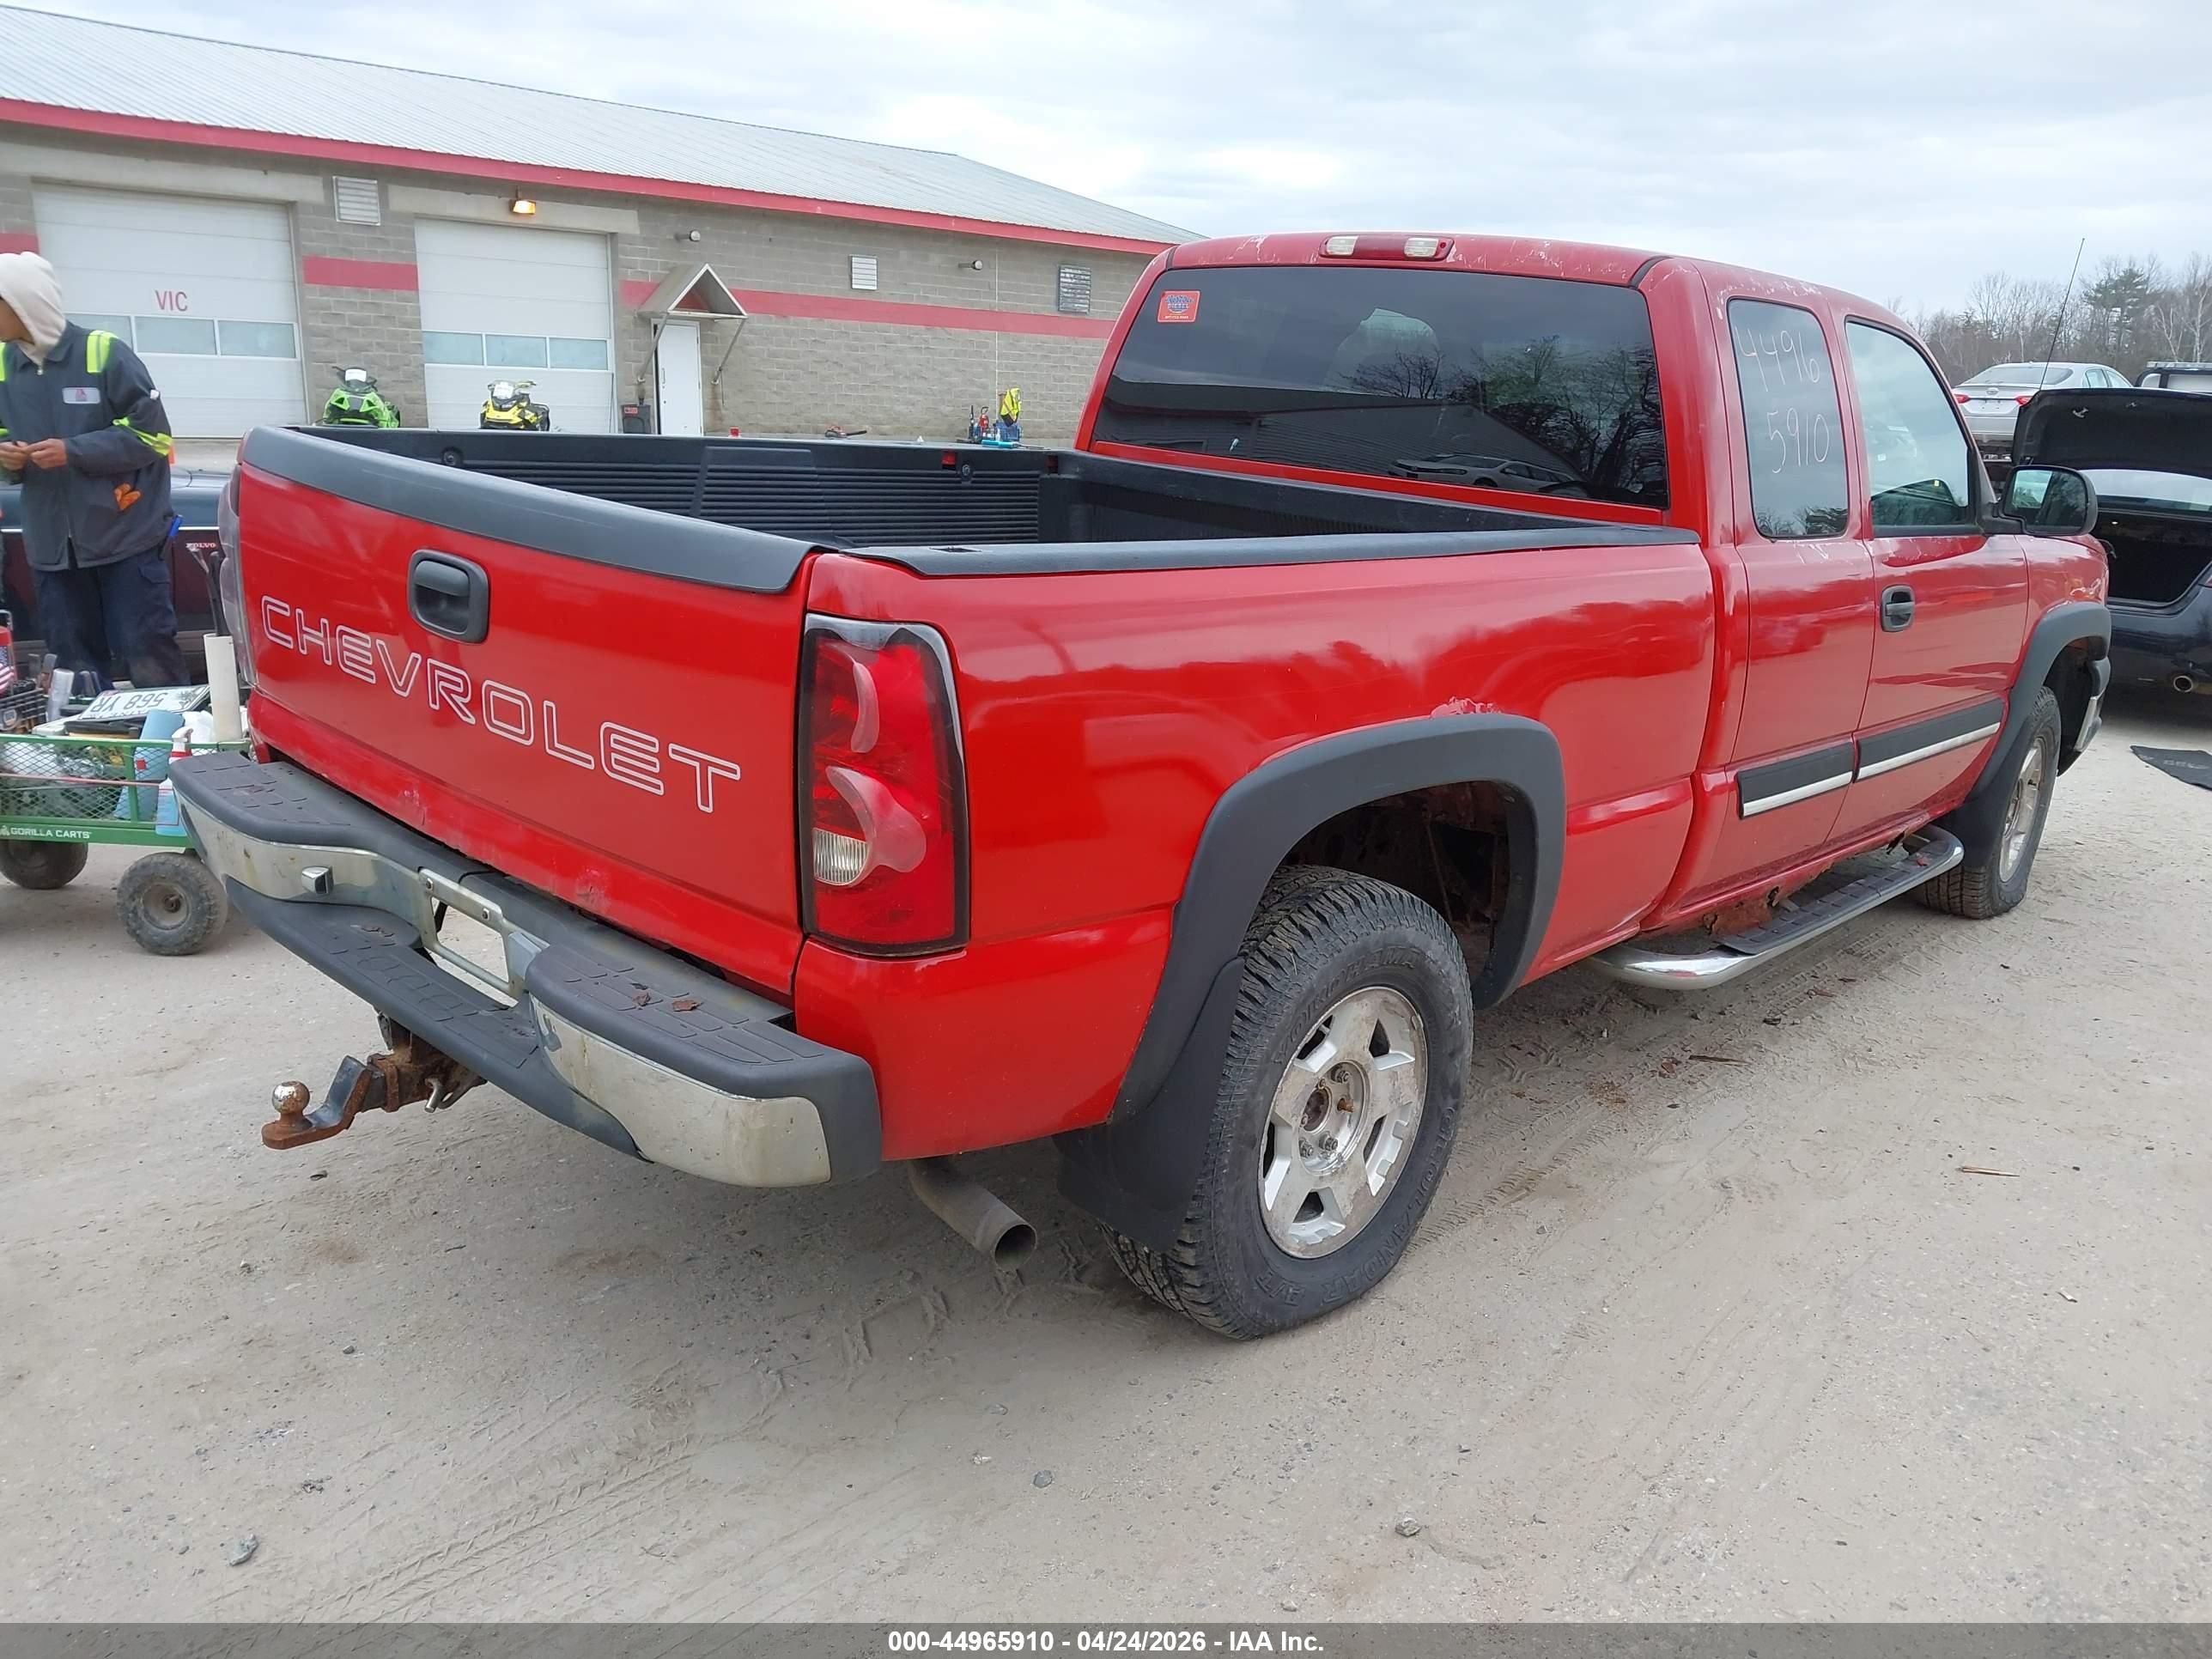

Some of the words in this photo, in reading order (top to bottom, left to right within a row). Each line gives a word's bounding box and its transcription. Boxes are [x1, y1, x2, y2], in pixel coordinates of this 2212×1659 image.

[155, 289, 187, 312] VIC
[1735, 325, 1820, 392] 4496
[1766, 408, 1829, 473] 5910
[90, 696, 119, 713] YR
[124, 692, 168, 710] 568
[261, 595, 740, 813] CHEVROLET
[10, 827, 53, 837] GORILLA
[55, 830, 90, 839] CARTS
